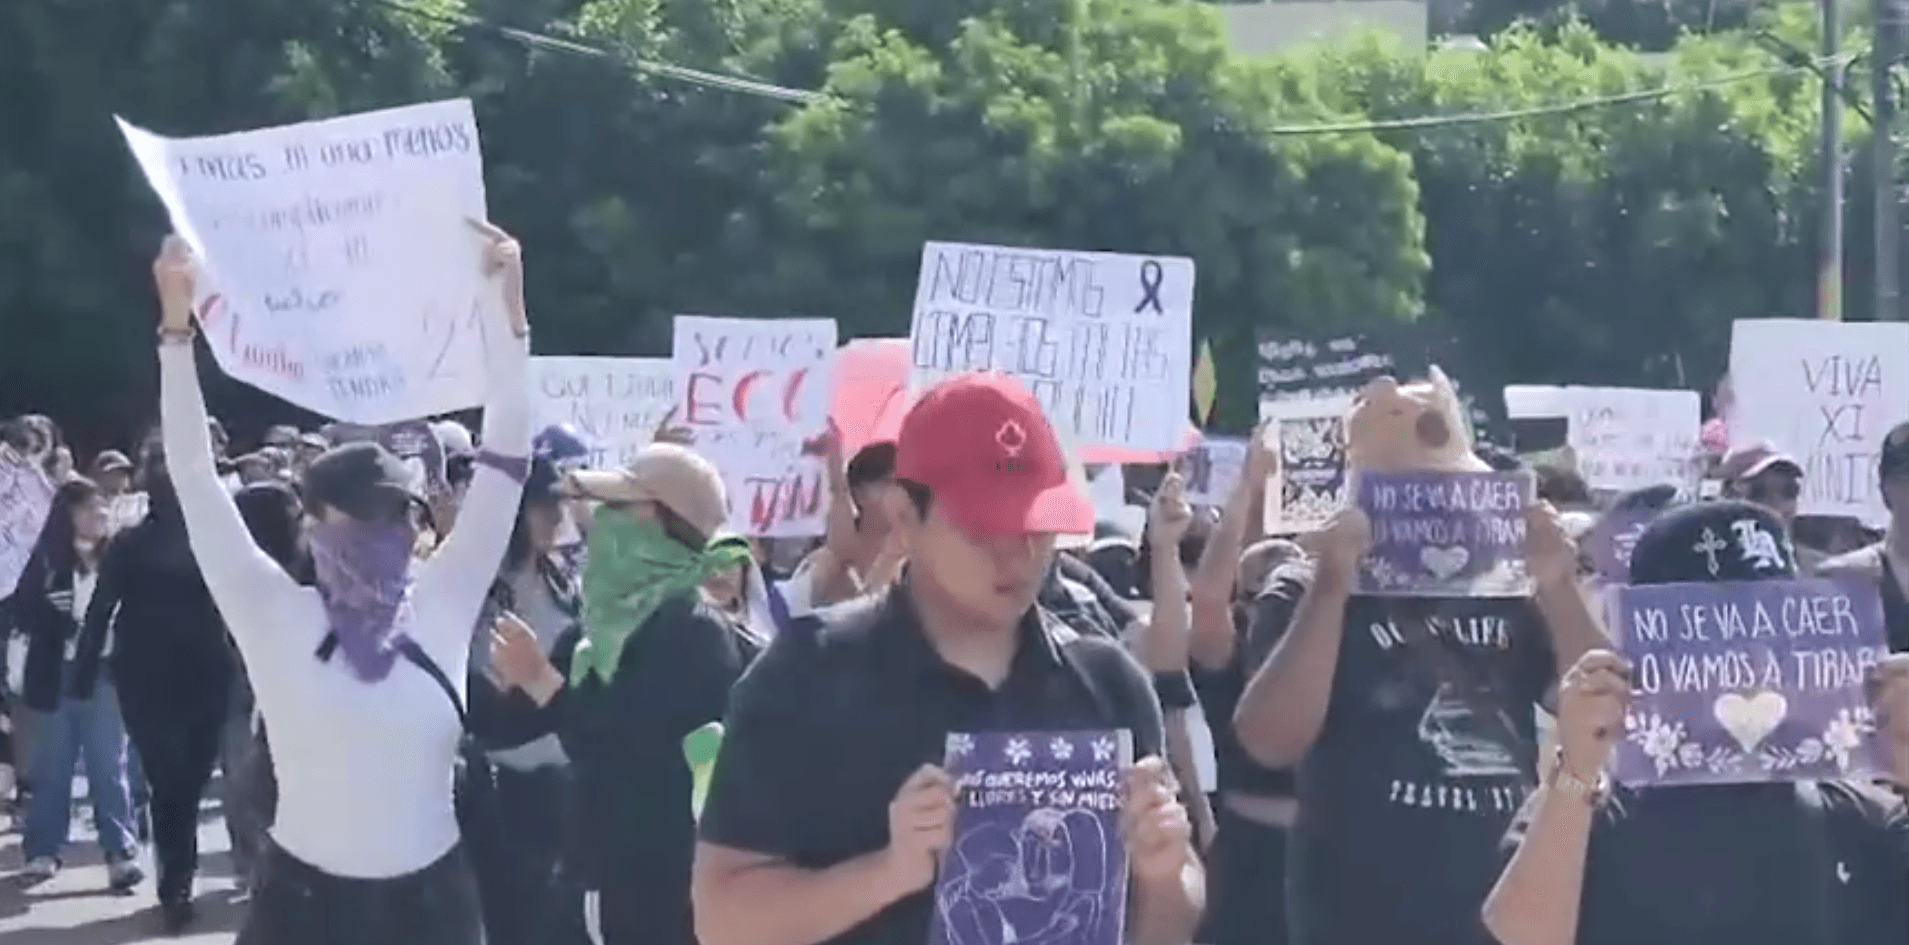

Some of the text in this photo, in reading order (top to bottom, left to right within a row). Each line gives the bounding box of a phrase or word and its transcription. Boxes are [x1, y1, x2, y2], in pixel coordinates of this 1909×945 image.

[1802, 355, 1882, 397] VIVA
[1405, 483, 1422, 511] SE
[1450, 480, 1466, 509] A
[1469, 479, 1520, 511] CAER
[1454, 520, 1466, 543] A
[1633, 595, 1859, 642] NO SE VA A CAER
[1669, 651, 1755, 692] VAMOS
[1763, 648, 1783, 690] A
[1791, 646, 1877, 692] TIRAR
[1032, 790, 1044, 805] Y
